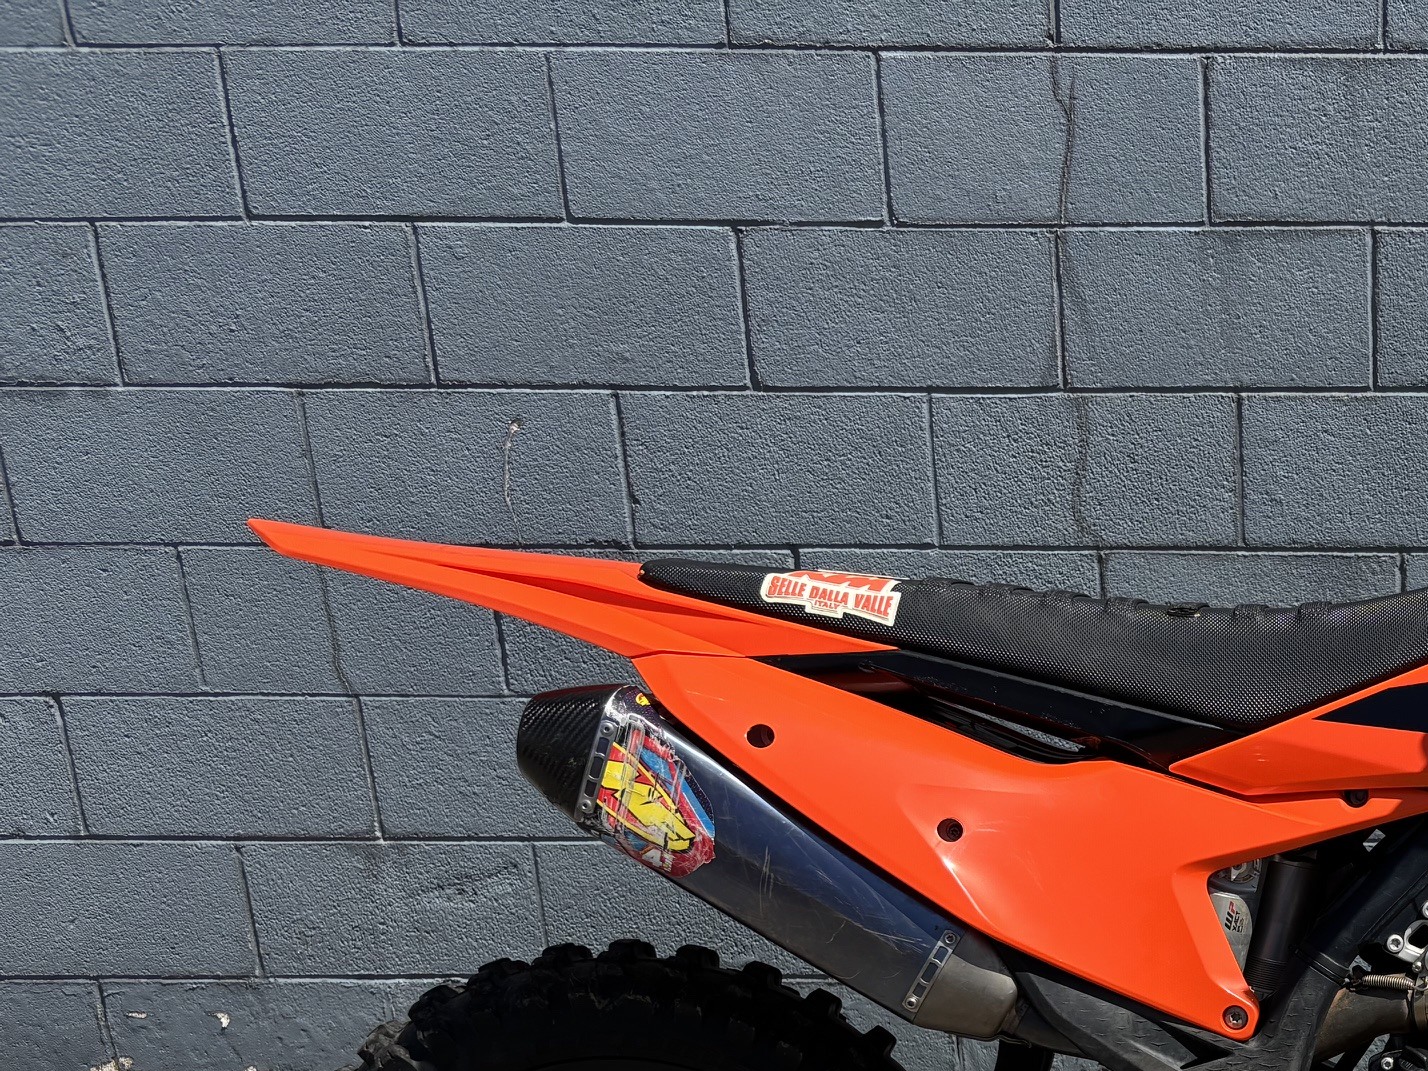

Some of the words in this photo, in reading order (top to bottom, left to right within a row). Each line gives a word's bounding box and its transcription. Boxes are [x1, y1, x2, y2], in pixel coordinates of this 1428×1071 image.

[767, 575, 807, 598] SELLE
[809, 585, 849, 606] DALLA
[854, 593, 893, 616] VALLE
[814, 599, 841, 610] ITALY
